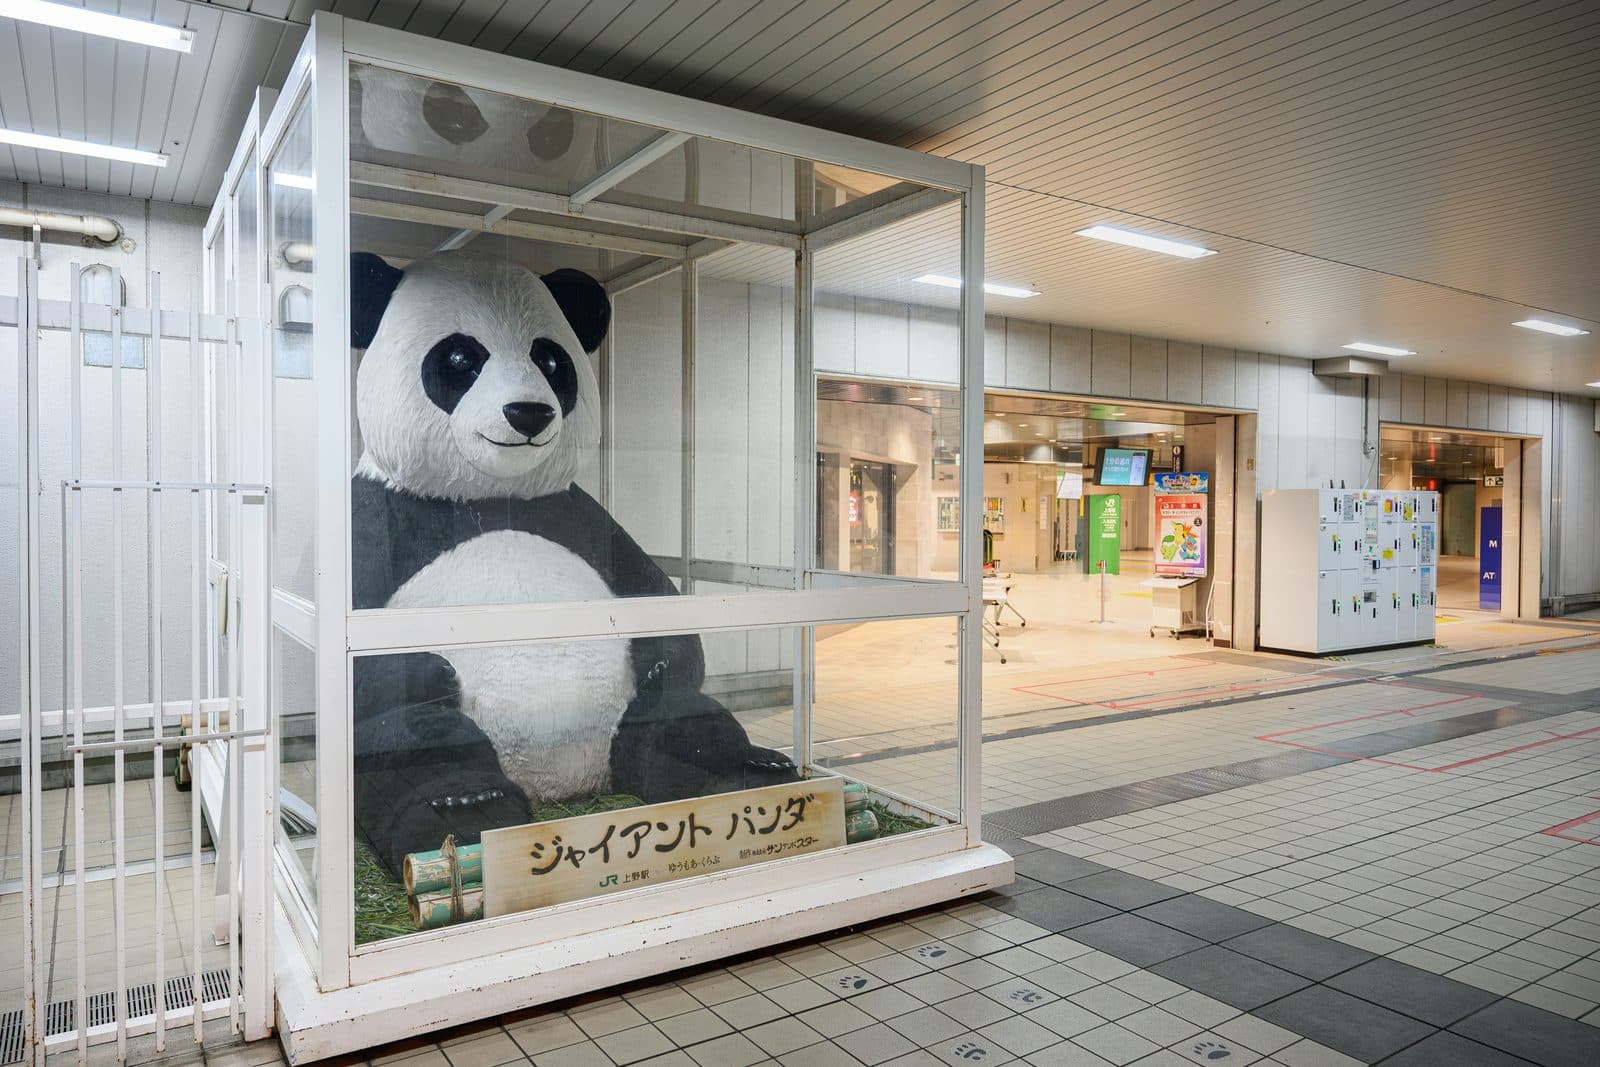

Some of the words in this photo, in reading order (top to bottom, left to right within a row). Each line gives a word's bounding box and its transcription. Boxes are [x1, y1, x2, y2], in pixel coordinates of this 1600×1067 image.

[531, 812, 712, 875] ジャイアント
[726, 793, 815, 840] パンダ
[599, 873, 619, 888] JR
[622, 869, 651, 884] 上野駅
